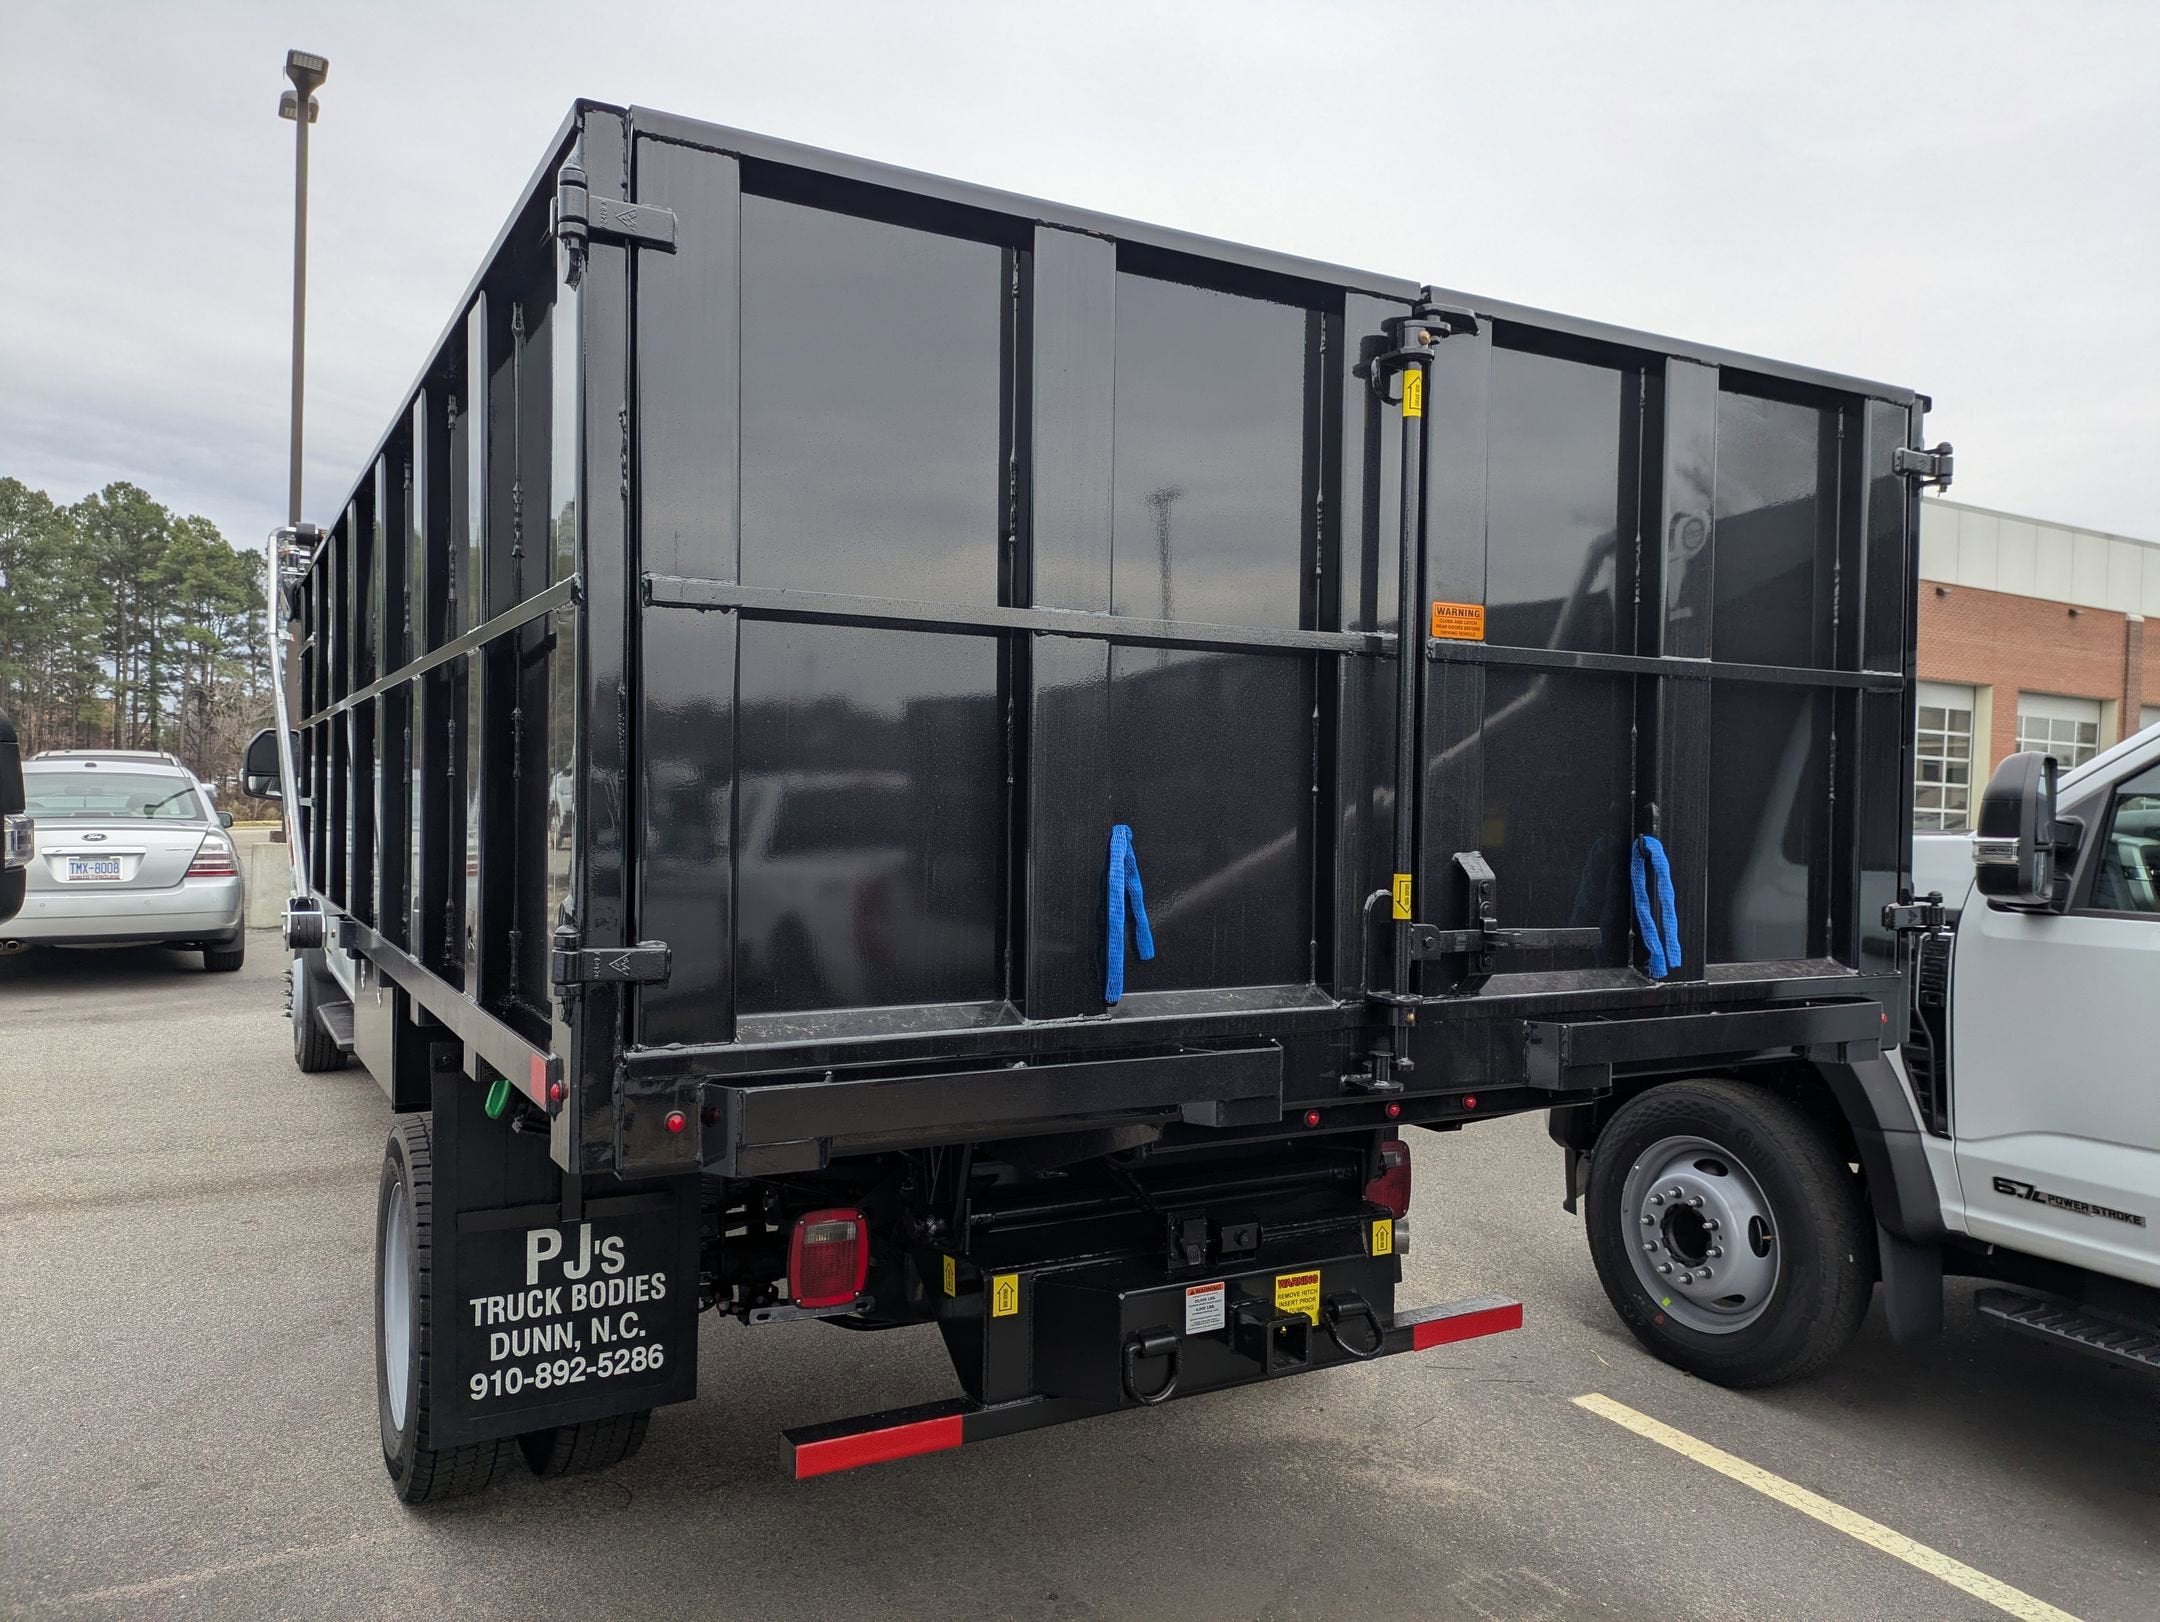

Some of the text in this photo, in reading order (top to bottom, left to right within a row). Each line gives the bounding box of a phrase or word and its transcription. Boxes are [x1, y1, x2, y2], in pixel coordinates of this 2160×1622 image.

[1436, 606, 1480, 618] WARNING
[70, 862, 119, 874] TMX-8008
[2047, 1193, 2089, 1214] POWER
[2092, 1204, 2143, 1226] STROKE
[1278, 1274, 1318, 1289] WARNING
[469, 1272, 666, 1327] TRUCK BODIES
[1278, 1291, 1300, 1299] REMOVE
[1279, 1296, 1316, 1307] INSERT PRIOR
[490, 1311, 646, 1362] DUNN, N.C.
[469, 1343, 664, 1401] 910-892-5286
